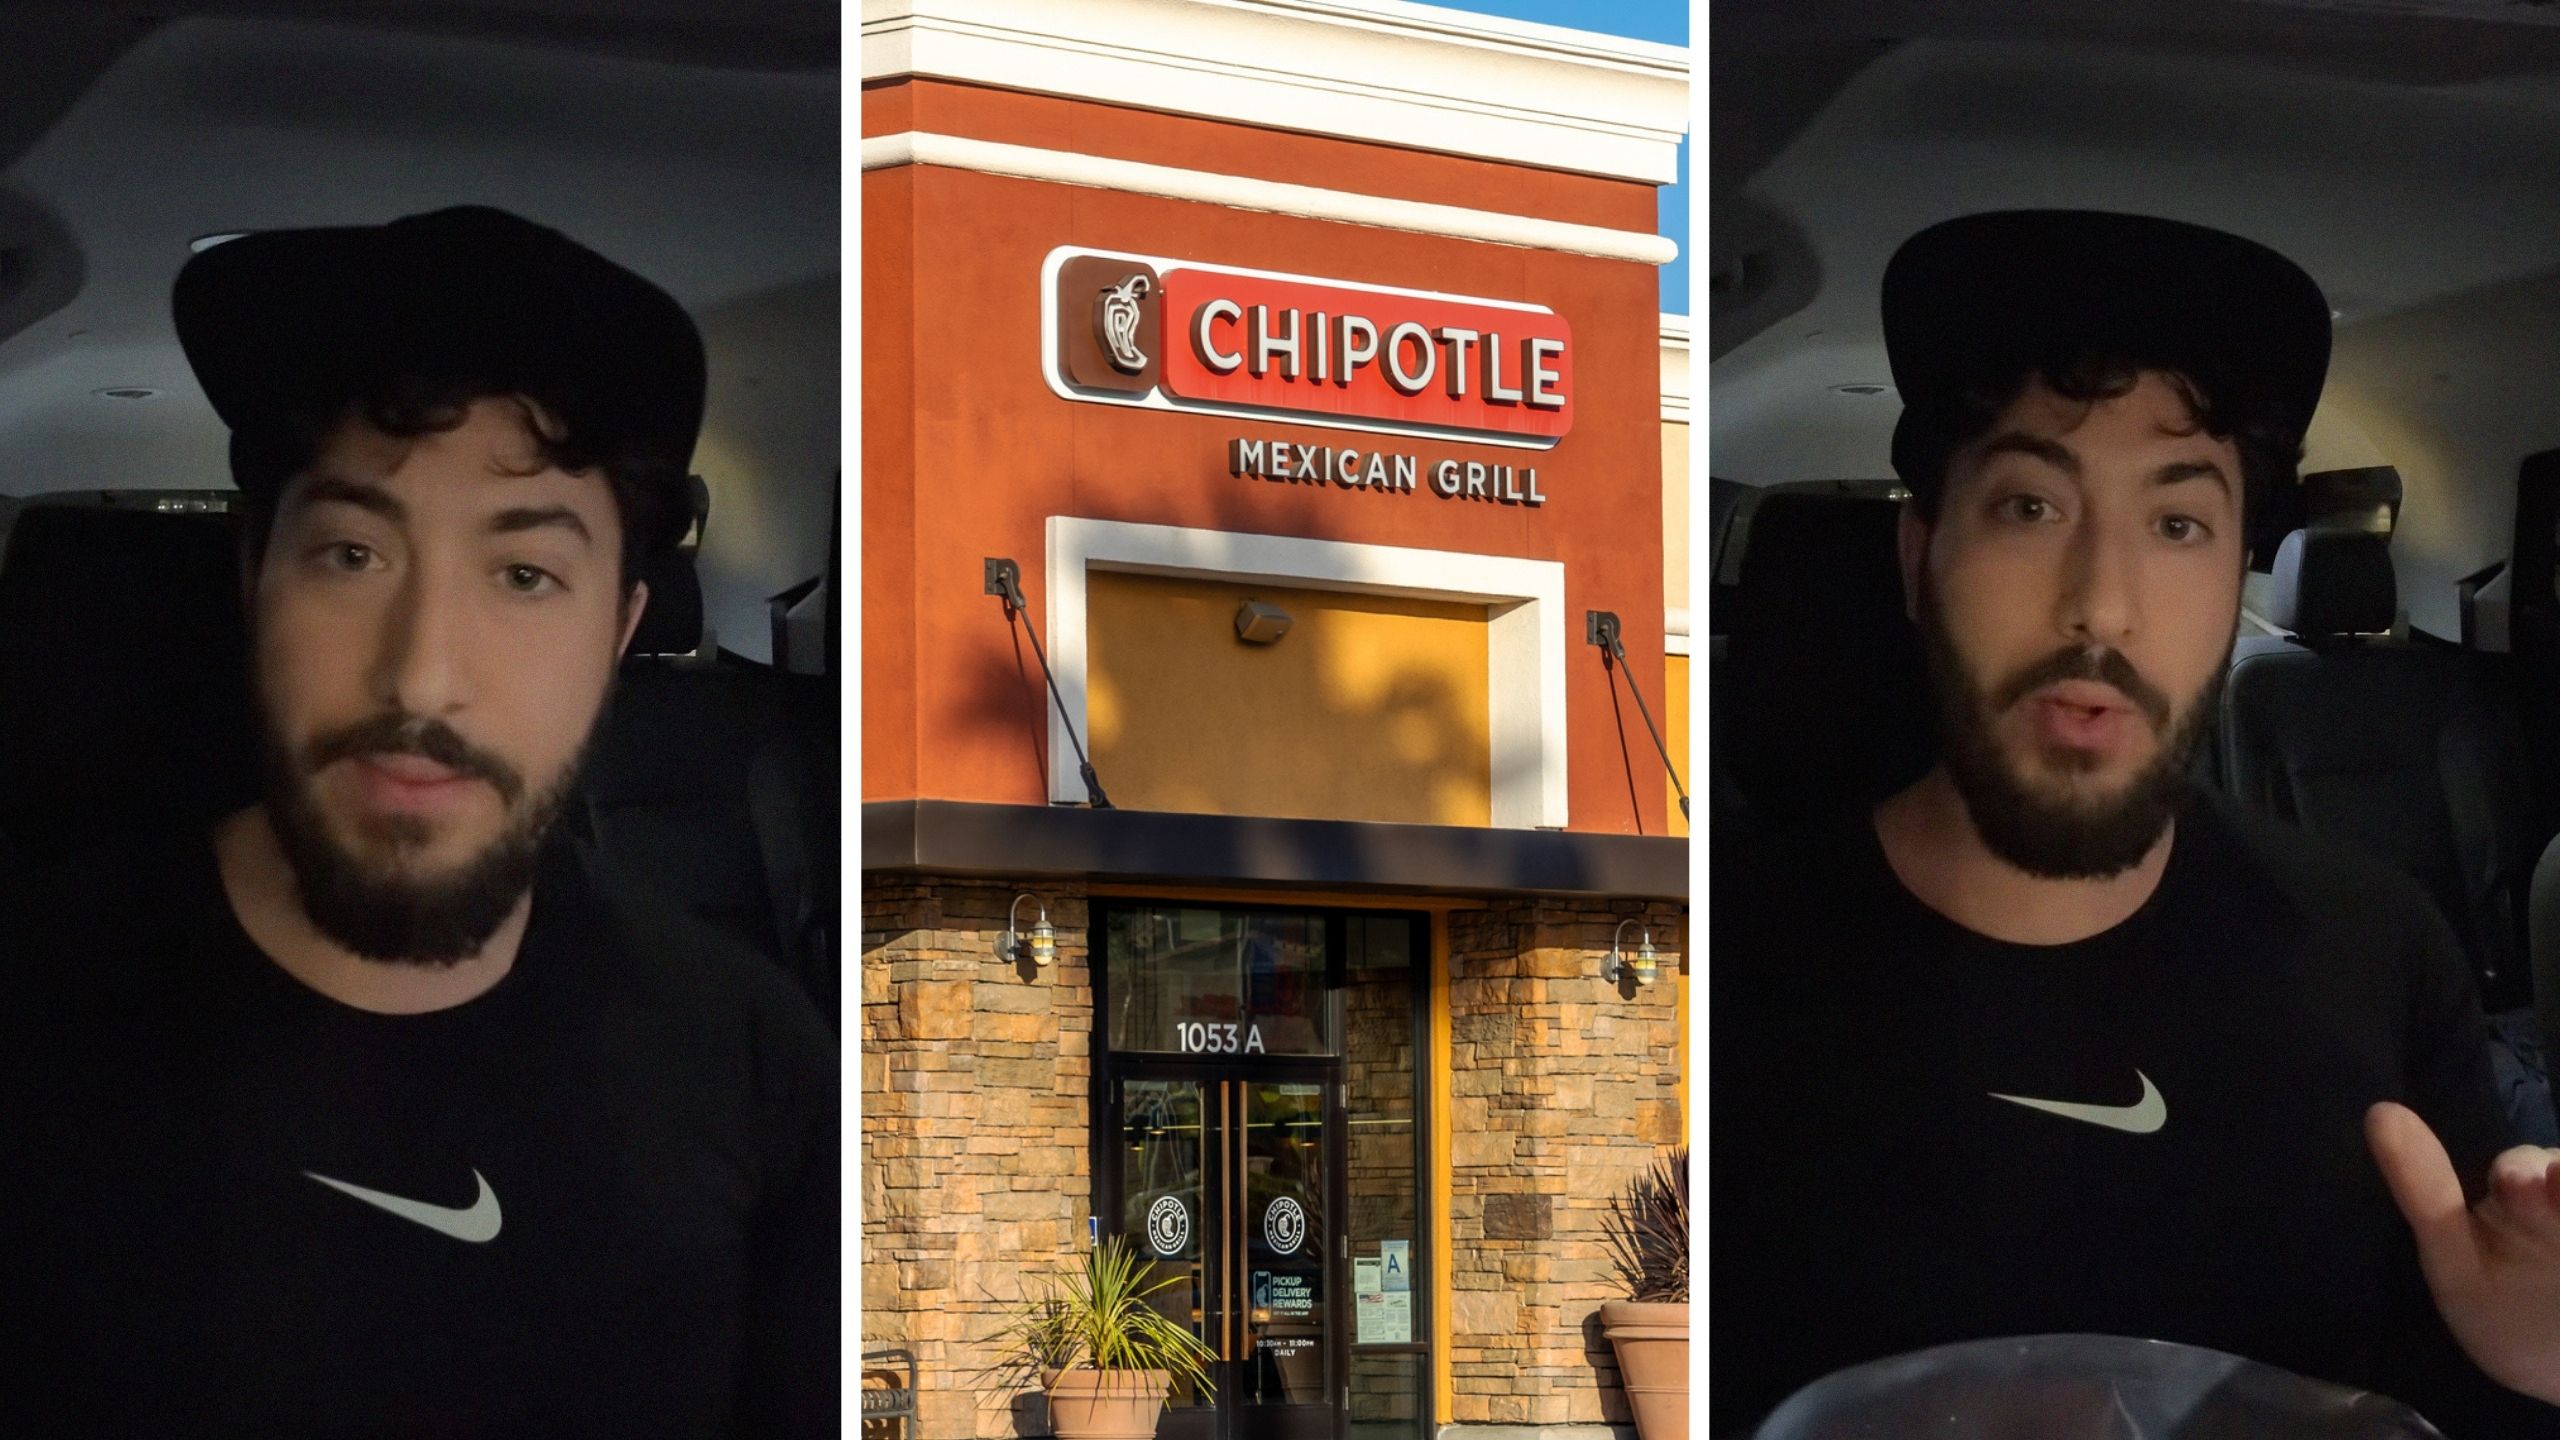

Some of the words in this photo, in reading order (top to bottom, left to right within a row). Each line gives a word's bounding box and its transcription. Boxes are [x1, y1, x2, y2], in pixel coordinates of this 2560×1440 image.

[1194, 298, 1566, 407] CHIPOTLE
[1232, 438, 1417, 491] MEXICAN
[1432, 459, 1546, 504] GRILL
[1176, 1022, 1238, 1053] 1053
[1244, 1023, 1266, 1054] A
[1151, 1200, 1186, 1222] CHIPOTLE
[1267, 1200, 1302, 1222] CHIPOTLE
[1387, 1253, 1401, 1273] A
[1272, 1276, 1302, 1286] PICKUP
[1272, 1287, 1312, 1297] DELIVERY
[1272, 1299, 1312, 1309] REWARDS
[1274, 1349, 1296, 1357] DAILY
